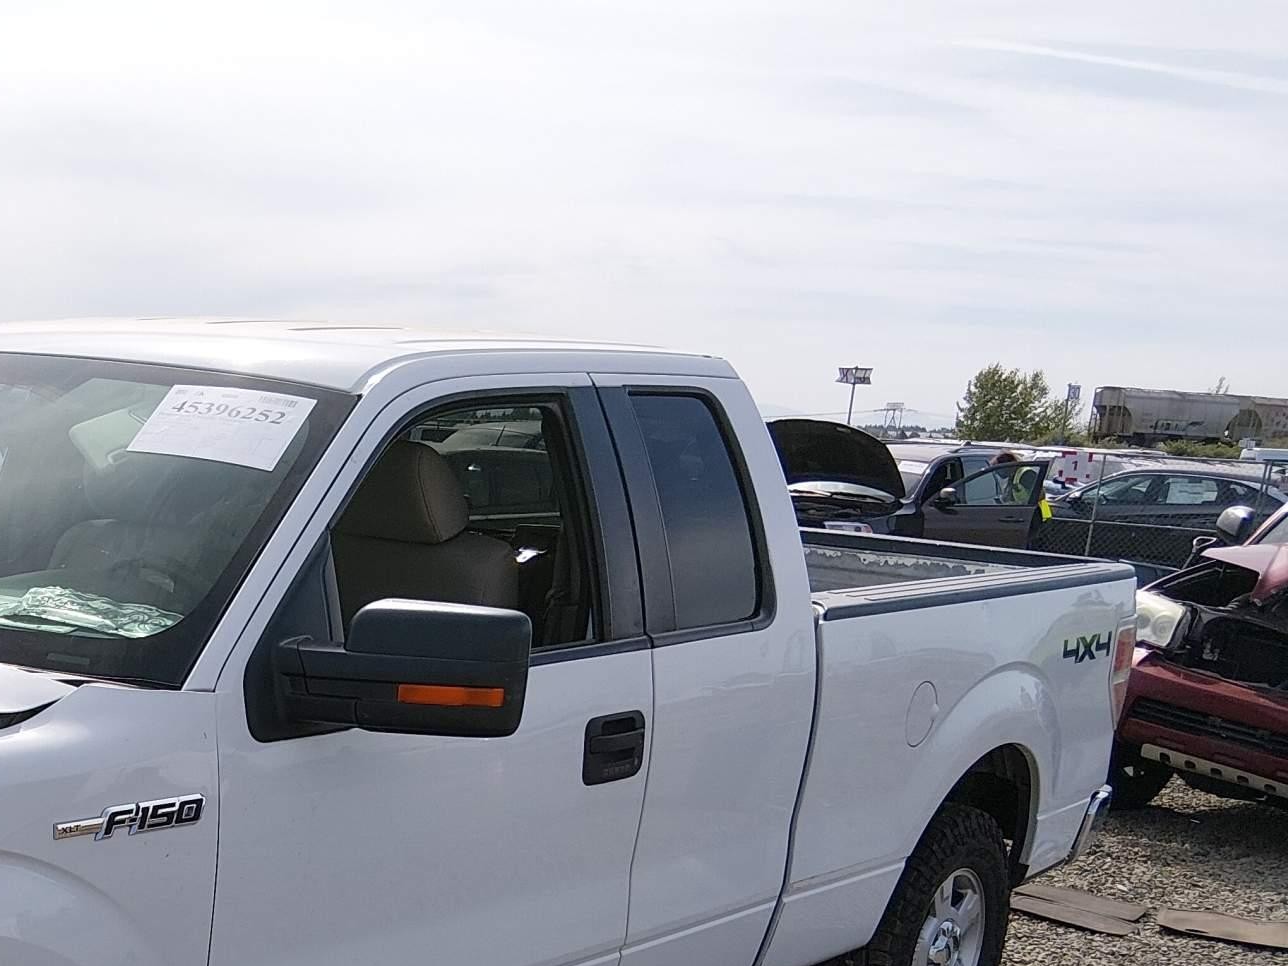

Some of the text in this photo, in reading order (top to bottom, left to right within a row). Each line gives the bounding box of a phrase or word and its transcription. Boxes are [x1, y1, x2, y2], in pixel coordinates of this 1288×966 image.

[171, 400, 286, 424] 45396252
[61, 794, 206, 840] XLT F-150
